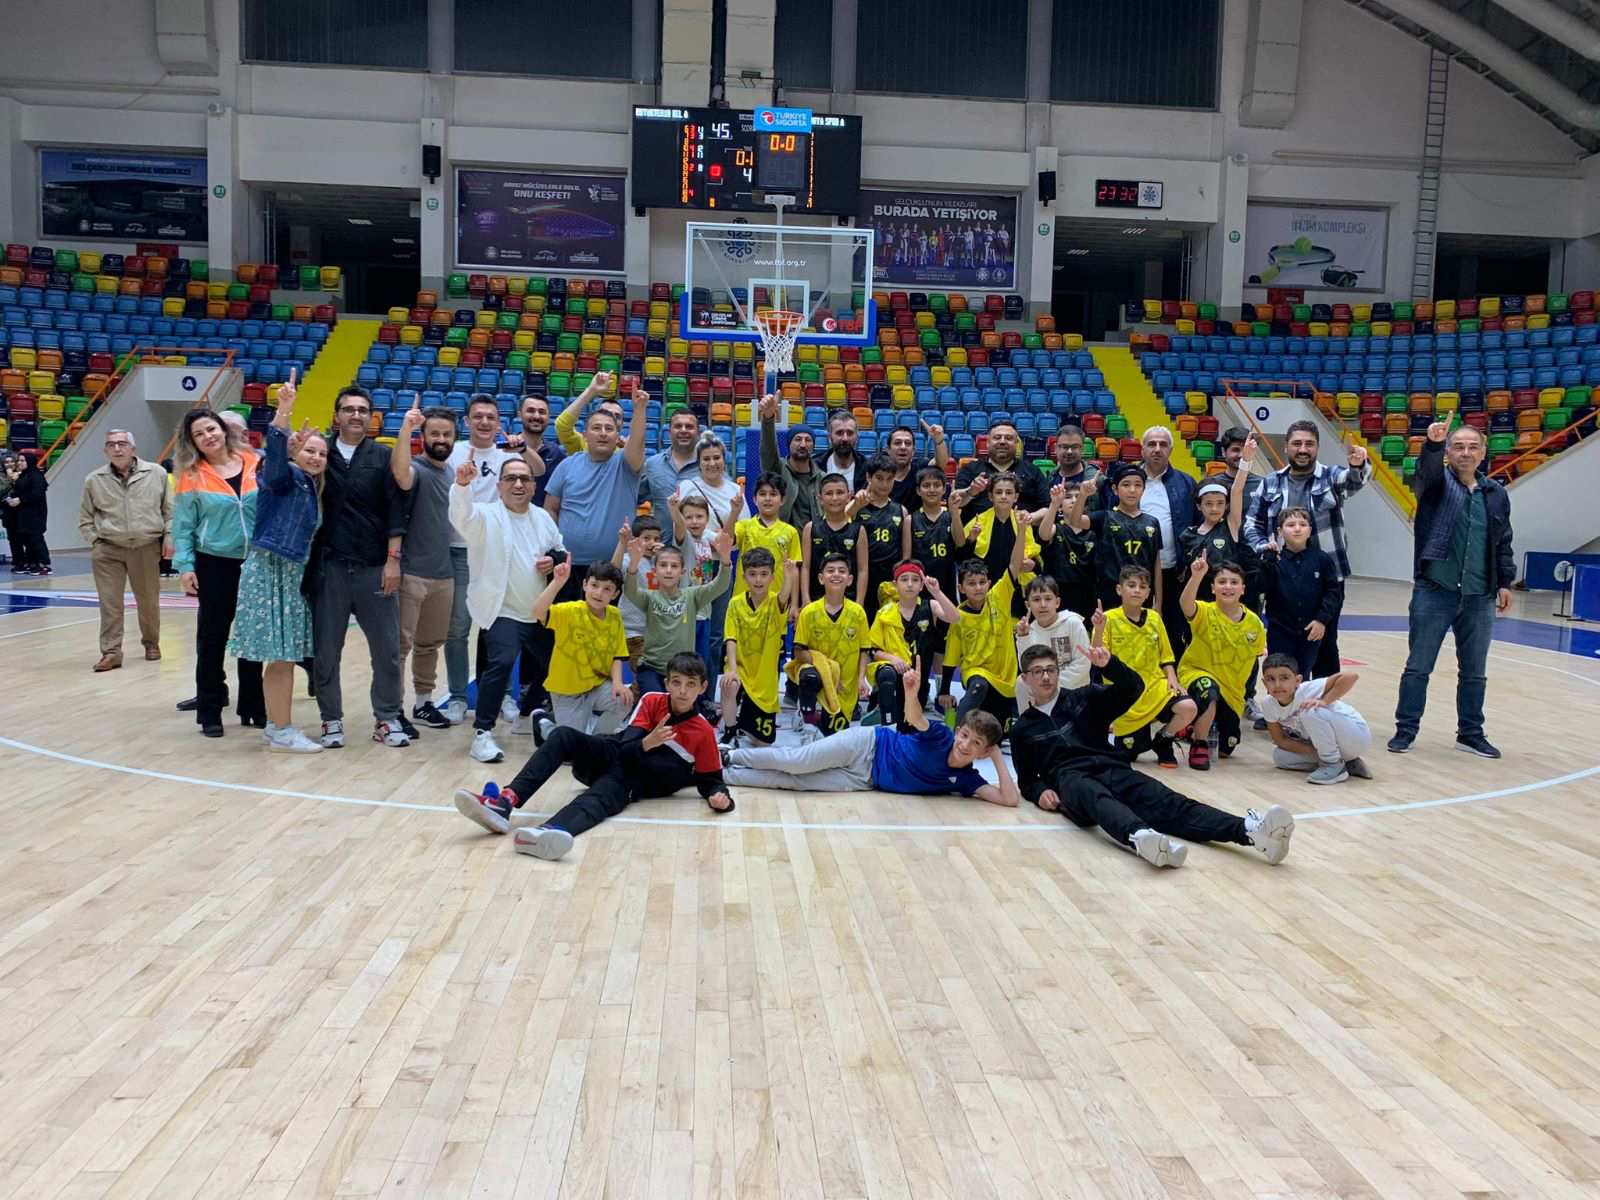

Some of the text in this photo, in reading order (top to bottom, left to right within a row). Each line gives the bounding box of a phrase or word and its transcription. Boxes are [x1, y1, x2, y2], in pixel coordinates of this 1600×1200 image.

[711, 122, 731, 139] 45
[513, 189, 571, 200] ONU KEŞFET!
[873, 204, 998, 222] BURADA YETİŞİYOR
[838, 319, 863, 332] TBF
[185, 379, 194, 388] A
[1258, 409, 1267, 418] B
[873, 527, 890, 543] 18
[929, 543, 947, 557] 16
[1124, 539, 1143, 555] 17
[1196, 677, 1212, 692] 19
[755, 716, 773, 737] 15
[828, 713, 847, 733] 10
